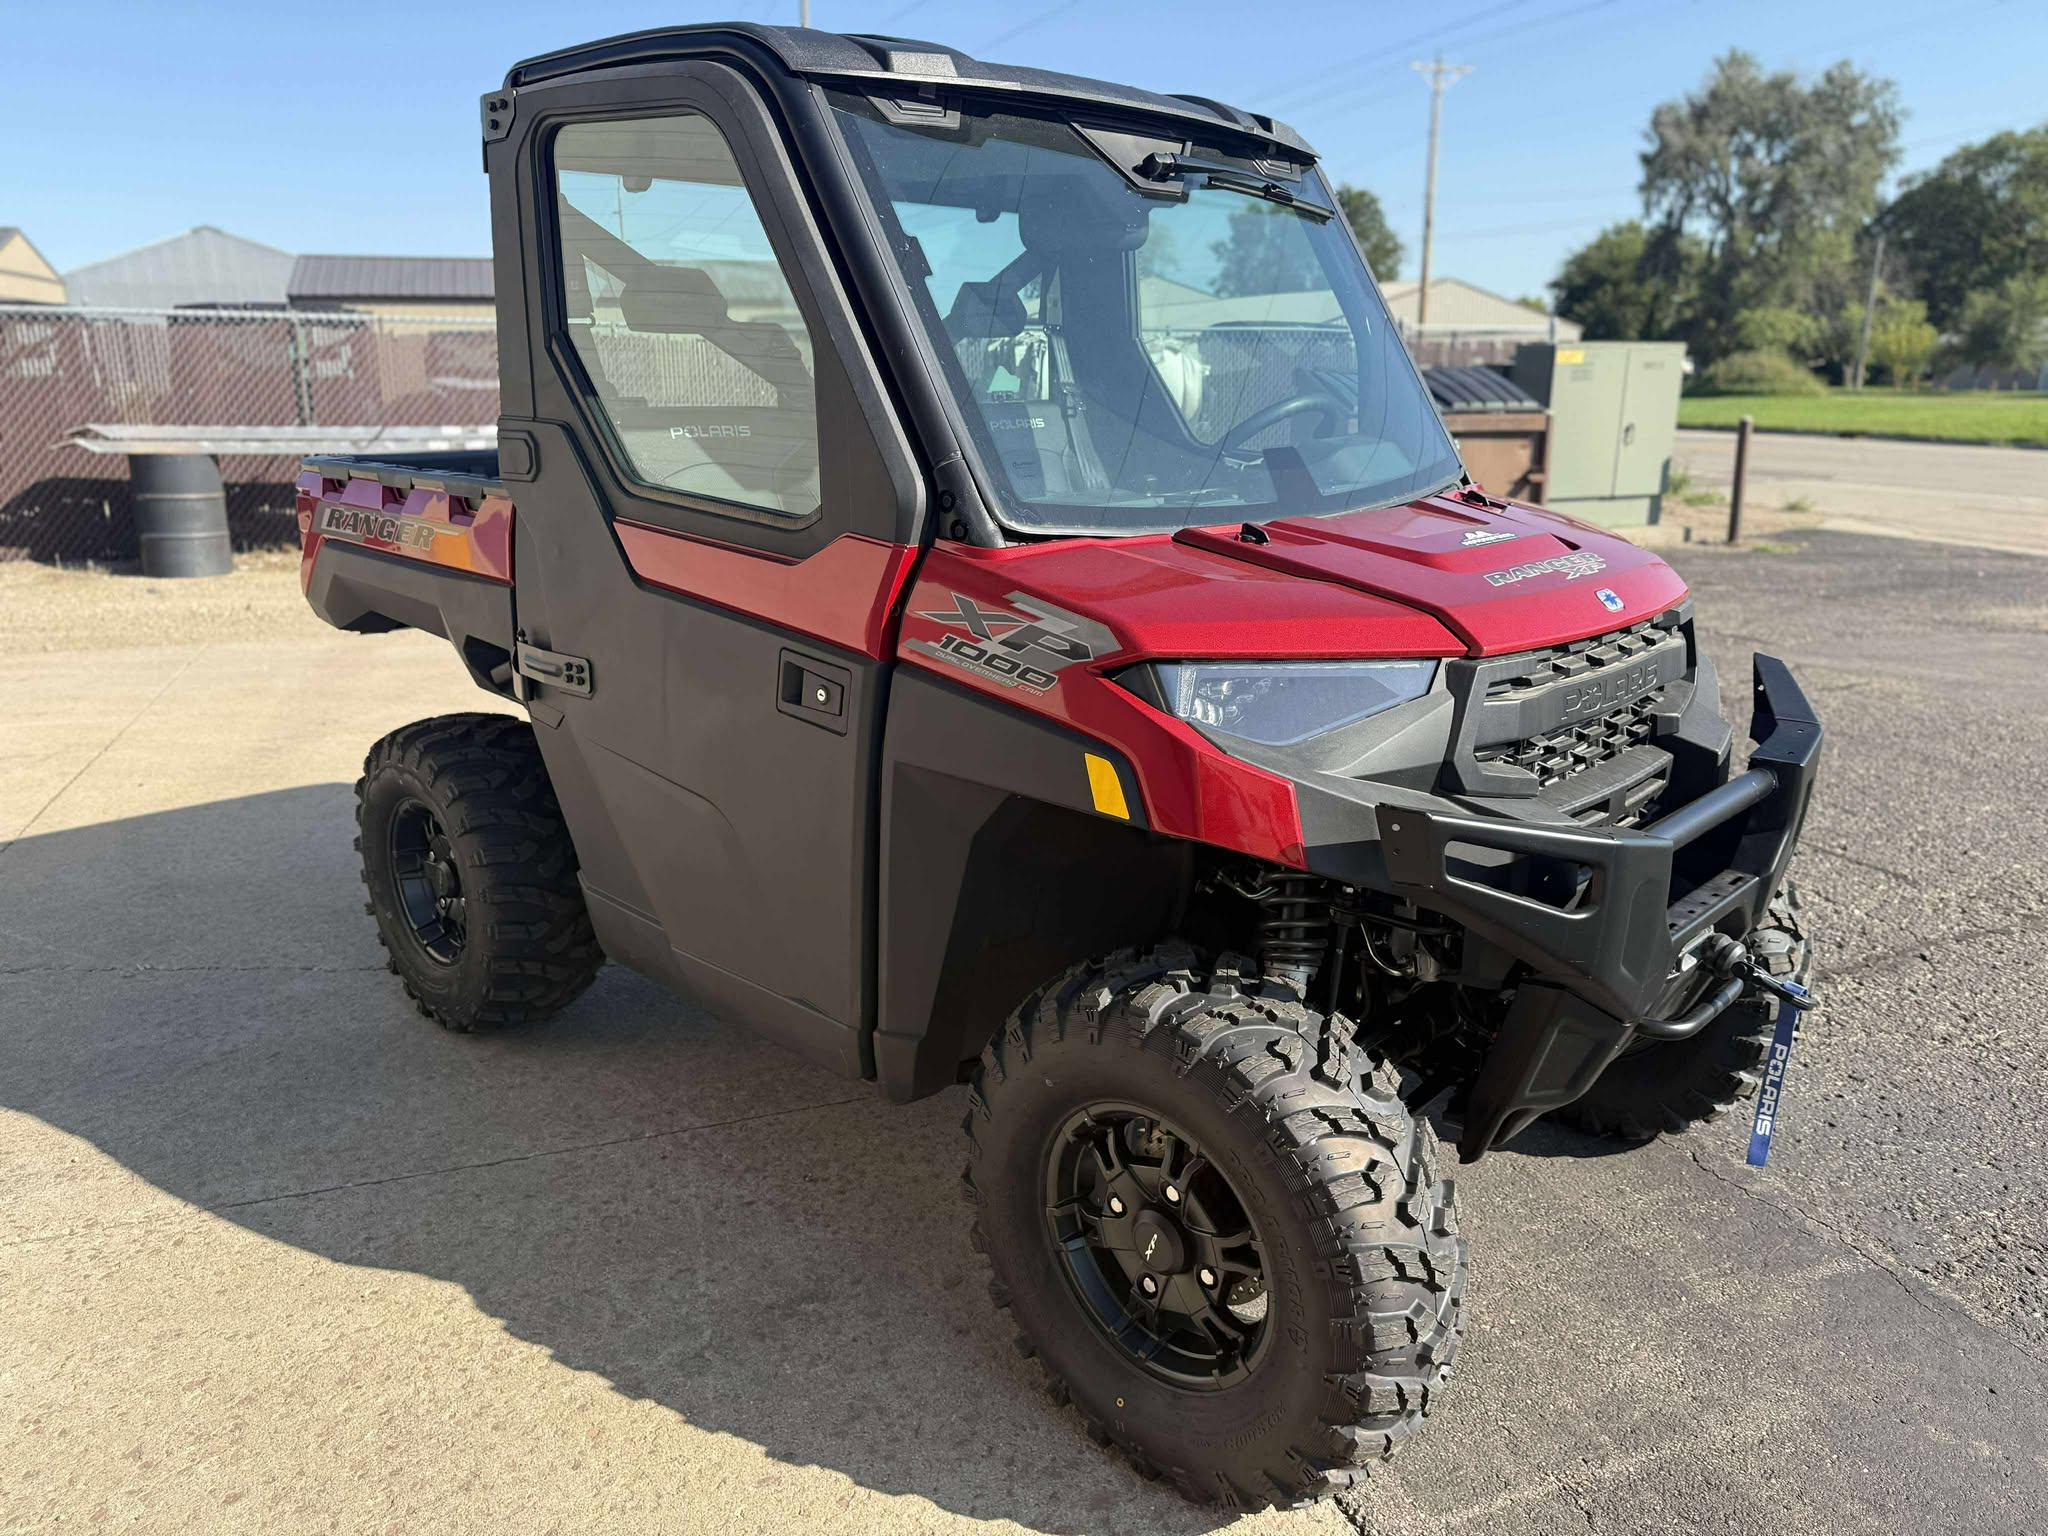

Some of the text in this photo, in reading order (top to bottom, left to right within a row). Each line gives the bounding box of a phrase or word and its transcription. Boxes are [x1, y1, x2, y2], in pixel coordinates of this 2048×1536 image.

[670, 425, 751, 440] POLARIS
[989, 418, 1045, 431] POLARIS
[326, 508, 437, 550] RANGER
[1484, 552, 1605, 587] RANGER
[1560, 563, 1607, 580] XP
[914, 592, 1094, 662] XP
[935, 650, 1044, 698] DUAL OVERHEAD CAM
[938, 633, 1059, 691] 1000
[1561, 664, 1658, 720] POLARIS
[1755, 1043, 1789, 1137] POLARIS
